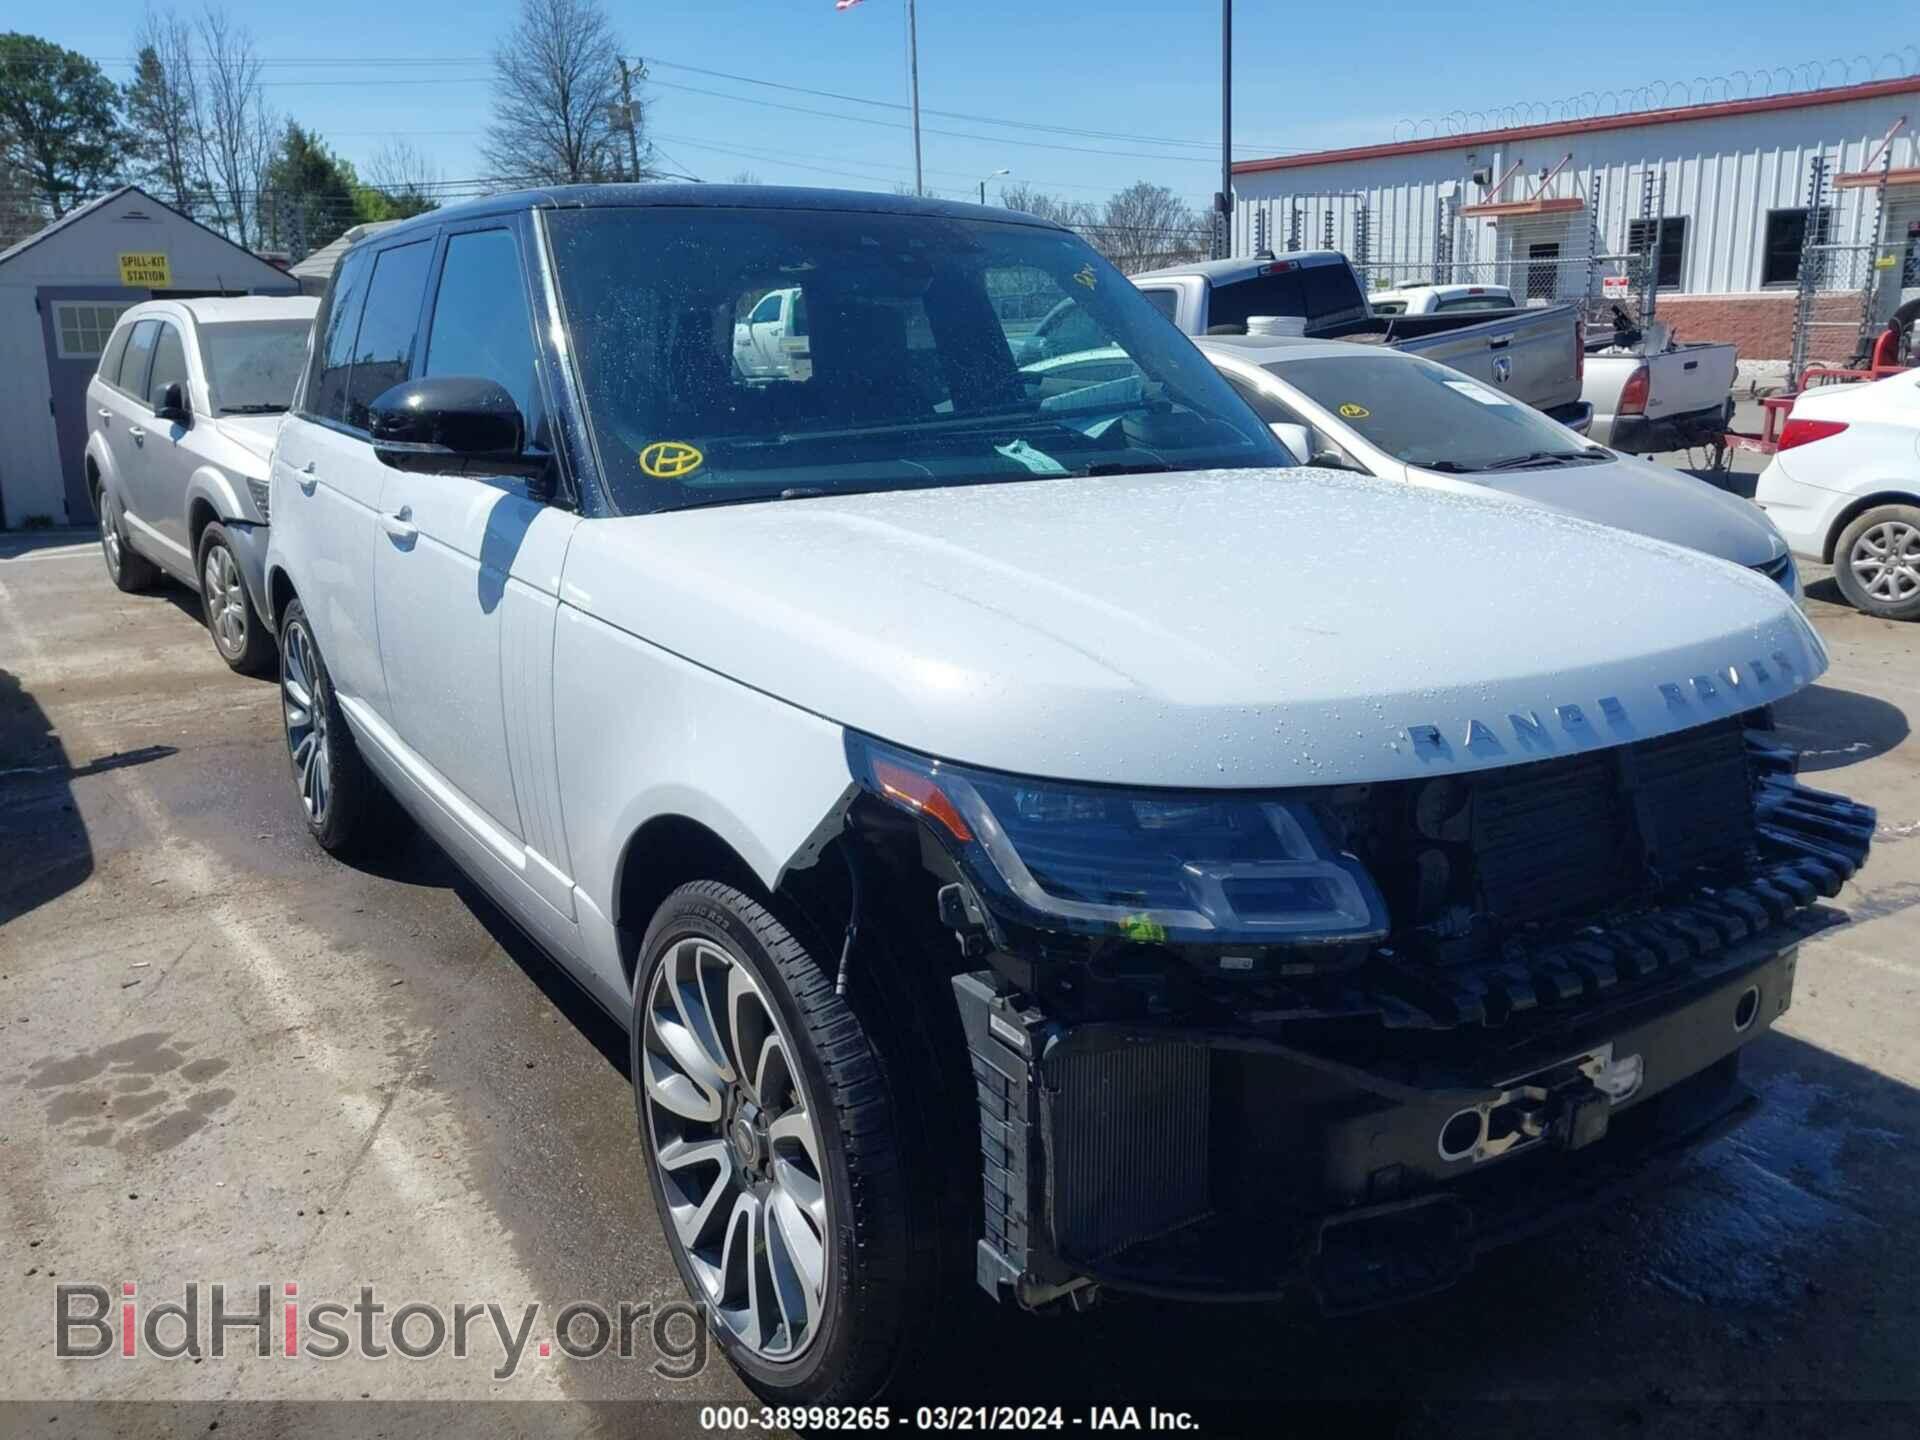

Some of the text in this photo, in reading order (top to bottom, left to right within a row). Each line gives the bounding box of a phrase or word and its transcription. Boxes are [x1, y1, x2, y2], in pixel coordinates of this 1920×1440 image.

[121, 255, 165, 267] SPILL-KIT
[127, 270, 165, 281] STATION
[1407, 650, 1793, 754] RANGE ROVER
